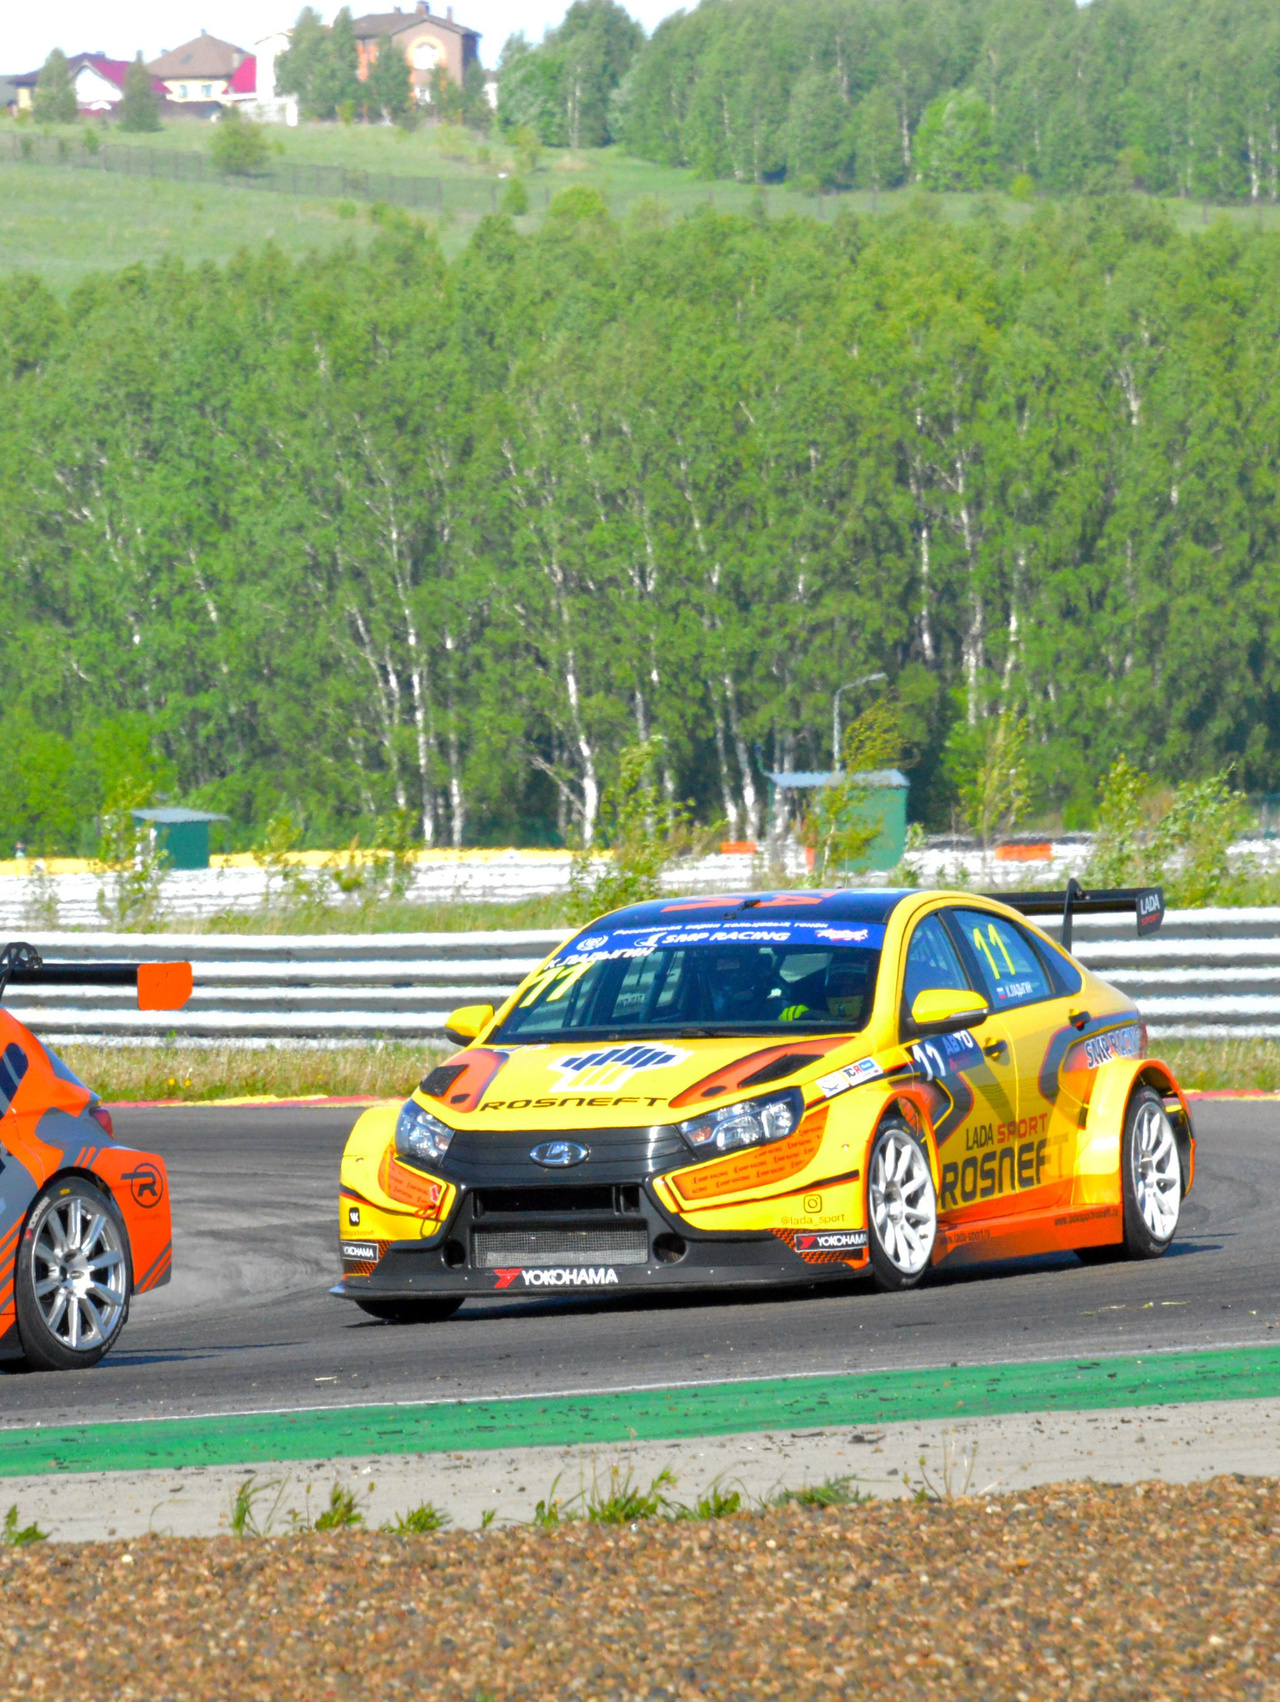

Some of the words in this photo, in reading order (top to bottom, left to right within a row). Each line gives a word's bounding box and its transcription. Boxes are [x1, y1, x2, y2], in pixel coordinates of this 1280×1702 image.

[1140, 894, 1160, 915] LADA
[661, 932, 710, 944] SMP
[708, 931, 791, 941] RACING
[973, 923, 1016, 980] 11
[519, 960, 597, 1008] 11
[941, 1029, 974, 1056] АВТО
[1084, 1035, 1115, 1070] SMP
[842, 1064, 863, 1078] TCR
[912, 1040, 947, 1081] 11
[479, 1097, 668, 1112] ROSNEFT
[965, 1122, 994, 1151] LADA
[997, 1112, 1048, 1144] SPORT
[940, 1132, 1069, 1209] ROSNEFT
[781, 1213, 845, 1226] @lada_sport
[521, 1267, 619, 1286] YOKOHAMA
